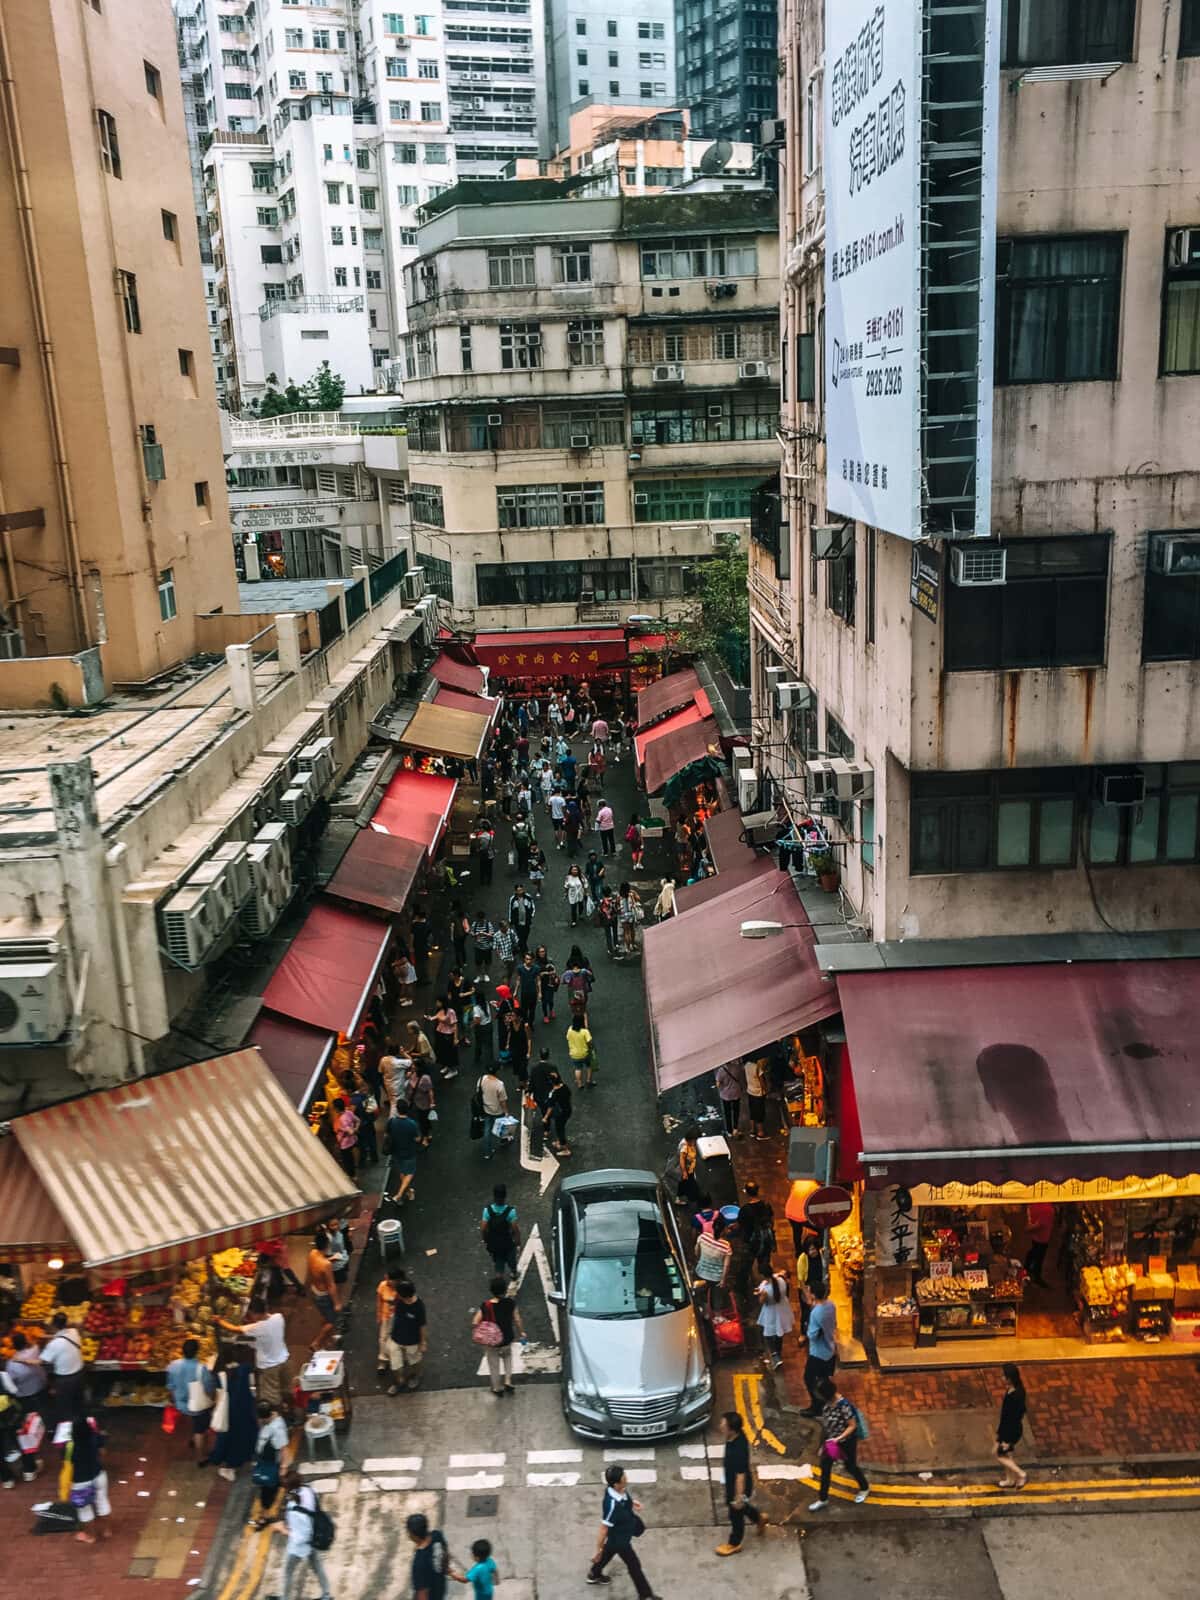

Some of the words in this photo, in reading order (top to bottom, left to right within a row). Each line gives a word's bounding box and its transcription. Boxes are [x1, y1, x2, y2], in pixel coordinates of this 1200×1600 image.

[860, 212, 905, 266] 6161.com.hk
[866, 368, 883, 397] 2926
[884, 365, 903, 396] 2926
[274, 516, 293, 526] FOOD
[297, 514, 325, 525] CENTRE
